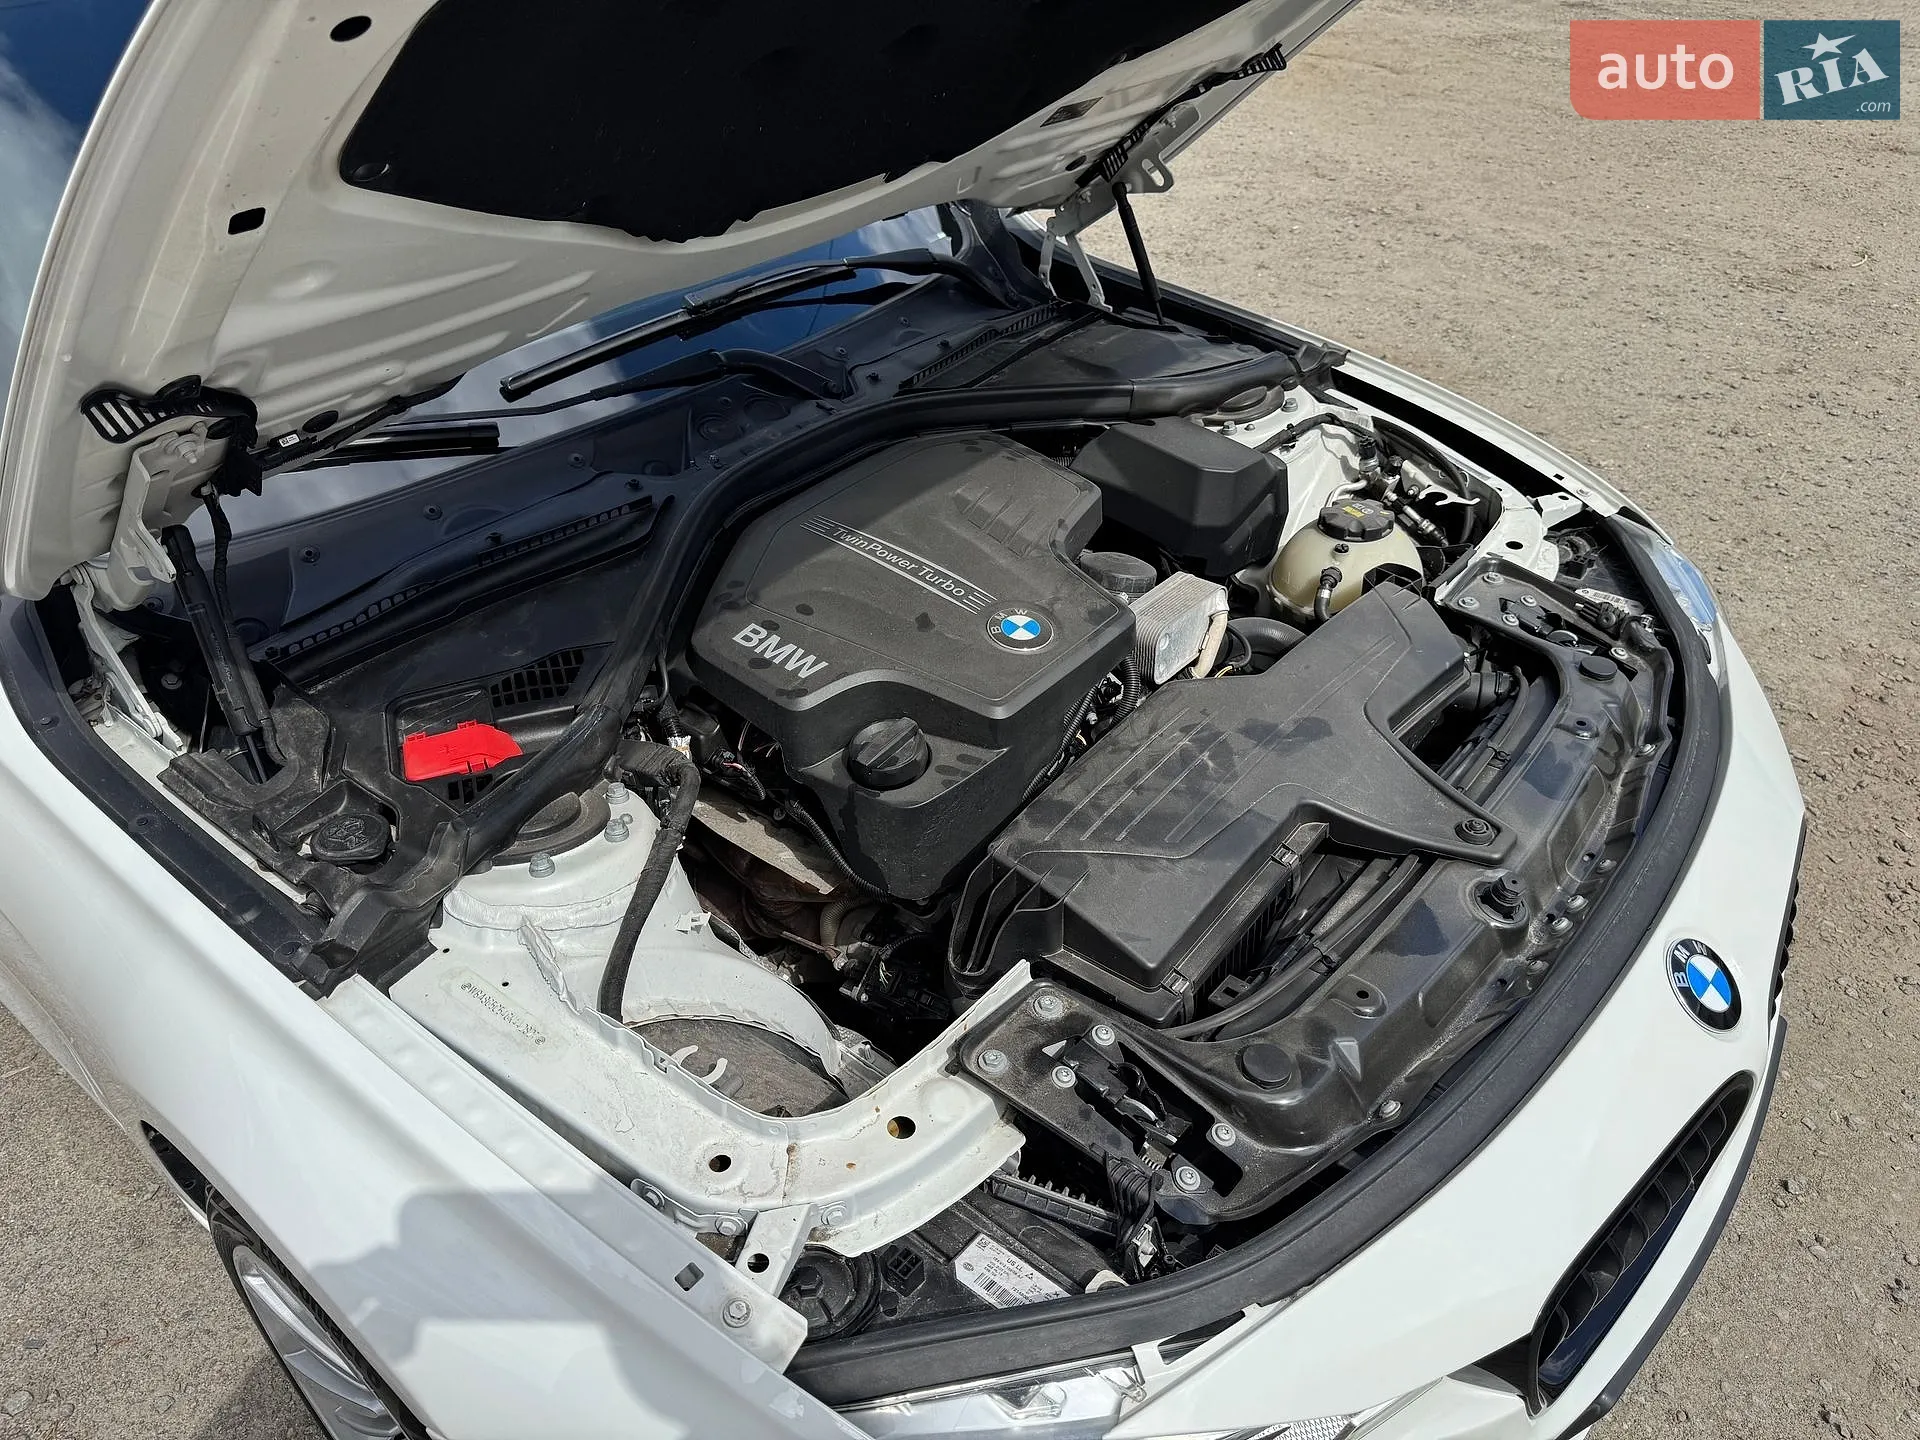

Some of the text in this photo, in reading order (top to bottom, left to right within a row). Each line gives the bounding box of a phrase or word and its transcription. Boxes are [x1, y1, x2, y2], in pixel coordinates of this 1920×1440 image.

[833, 527, 966, 597] TwinPower Turbo
[990, 607, 1028, 634] BMW
[732, 622, 829, 679] BMW
[1673, 940, 1708, 987] BMW
